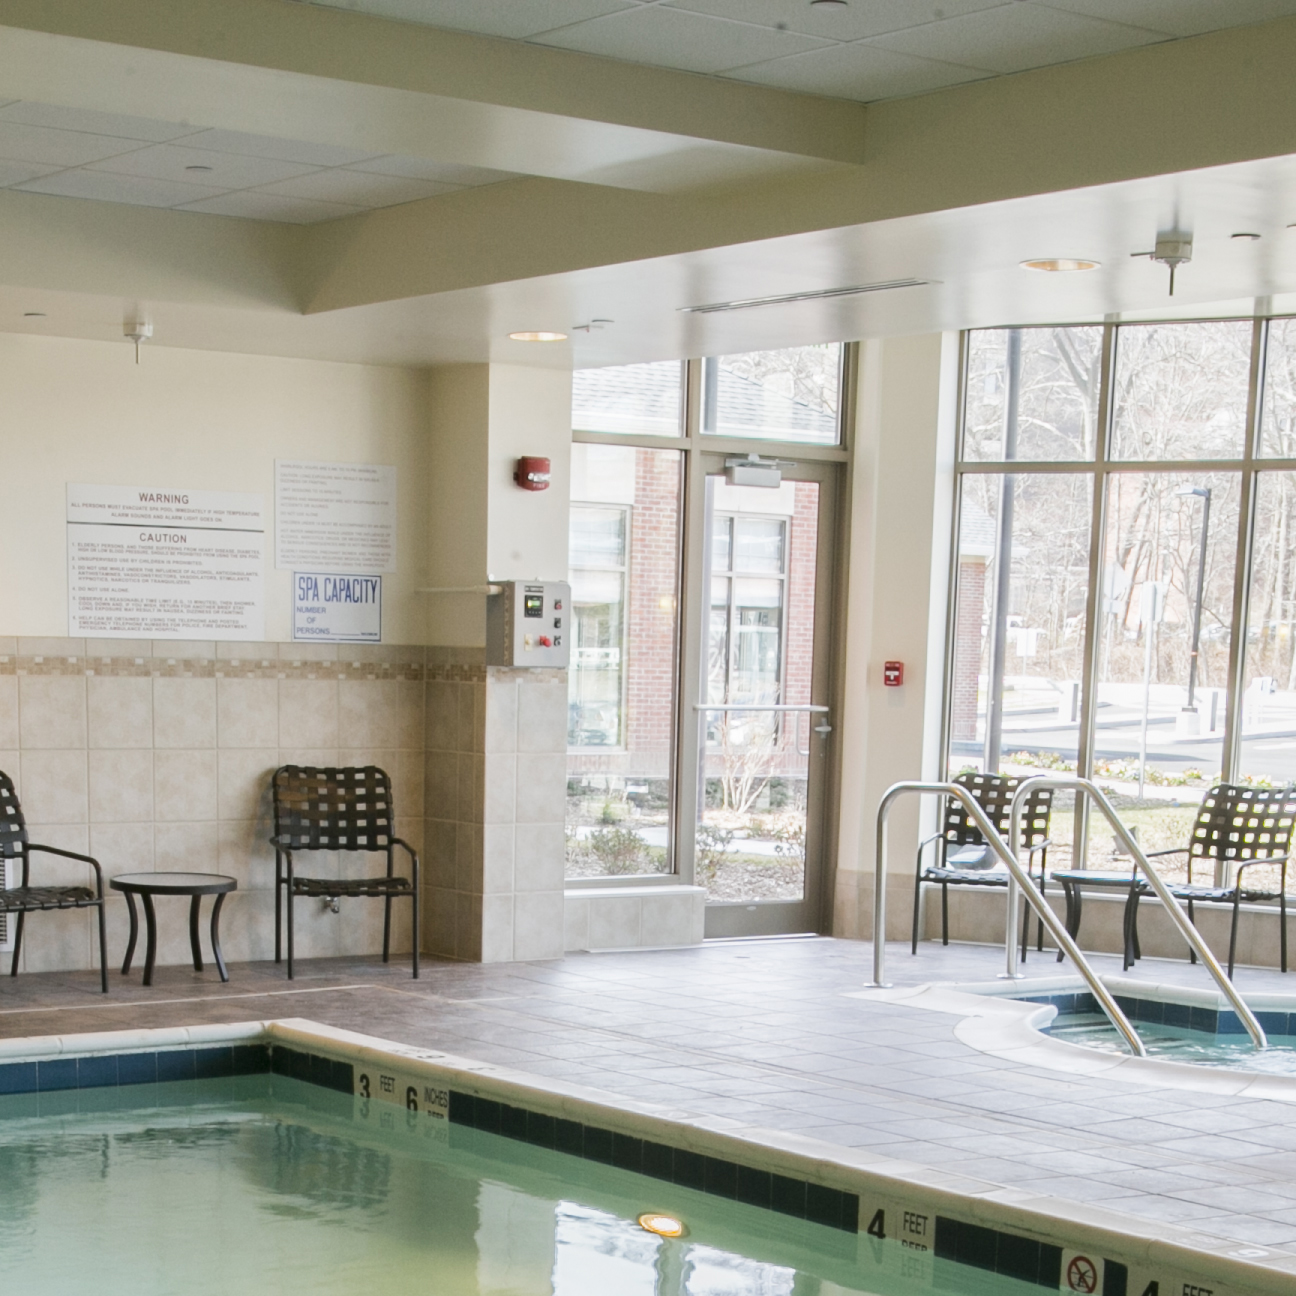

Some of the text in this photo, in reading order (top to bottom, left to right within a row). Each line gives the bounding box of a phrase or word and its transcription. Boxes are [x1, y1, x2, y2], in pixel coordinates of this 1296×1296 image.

[138, 492, 189, 504] WARNING
[139, 532, 187, 544] CAUTION
[298, 576, 377, 604] SPA CAPACITY
[296, 606, 326, 614] NUMBER
[306, 616, 316, 624] OF
[296, 626, 330, 635] PERSONS
[360, 1074, 448, 1111] 3 FEET 6 INCHES
[867, 1208, 928, 1239] 4 FEET
